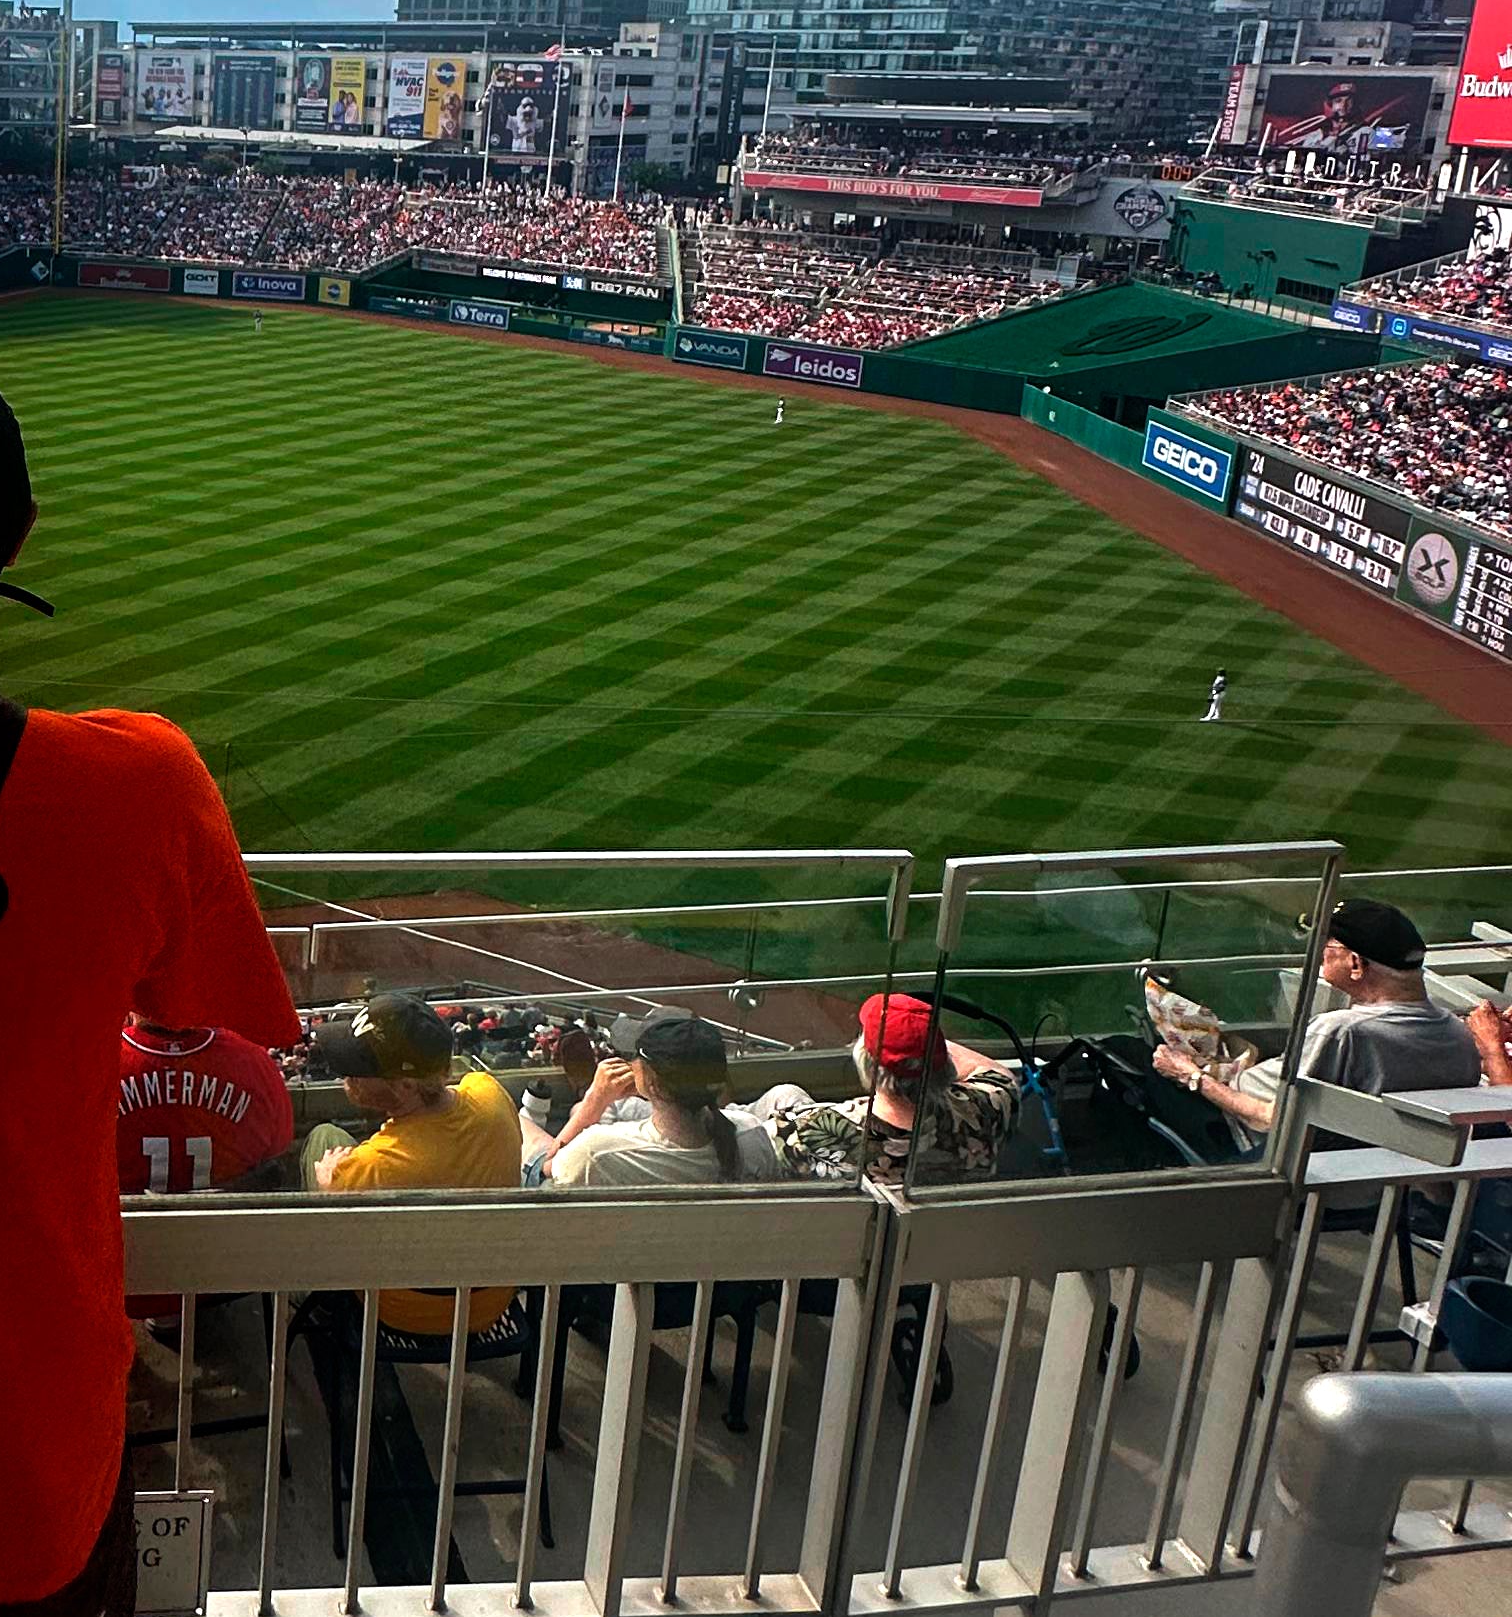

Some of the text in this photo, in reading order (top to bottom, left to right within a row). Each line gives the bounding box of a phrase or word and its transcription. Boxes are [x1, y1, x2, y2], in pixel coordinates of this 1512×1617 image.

[395, 77, 425, 87] HVAC
[405, 86, 423, 97] 911
[1460, 74, 1512, 97] Budw
[1220, 81, 1240, 141] TEAM STORE
[827, 179, 942, 198] THIS BUD'S FOR YOU.
[258, 278, 296, 291] Inova
[626, 285, 659, 299] FAN
[468, 307, 504, 326] Terra
[1334, 310, 1360, 324] GEICO
[693, 341, 740, 357] VANDA
[794, 355, 857, 381] leidos
[1153, 436, 1217, 484] GEICO
[1294, 471, 1324, 501] CADE
[1322, 485, 1366, 521] CAVALLI
[1491, 626, 1505, 641] TEX
[1487, 638, 1505, 652] HOU
[142, 1137, 212, 1193] 11
[152, 1517, 190, 1537] OF
